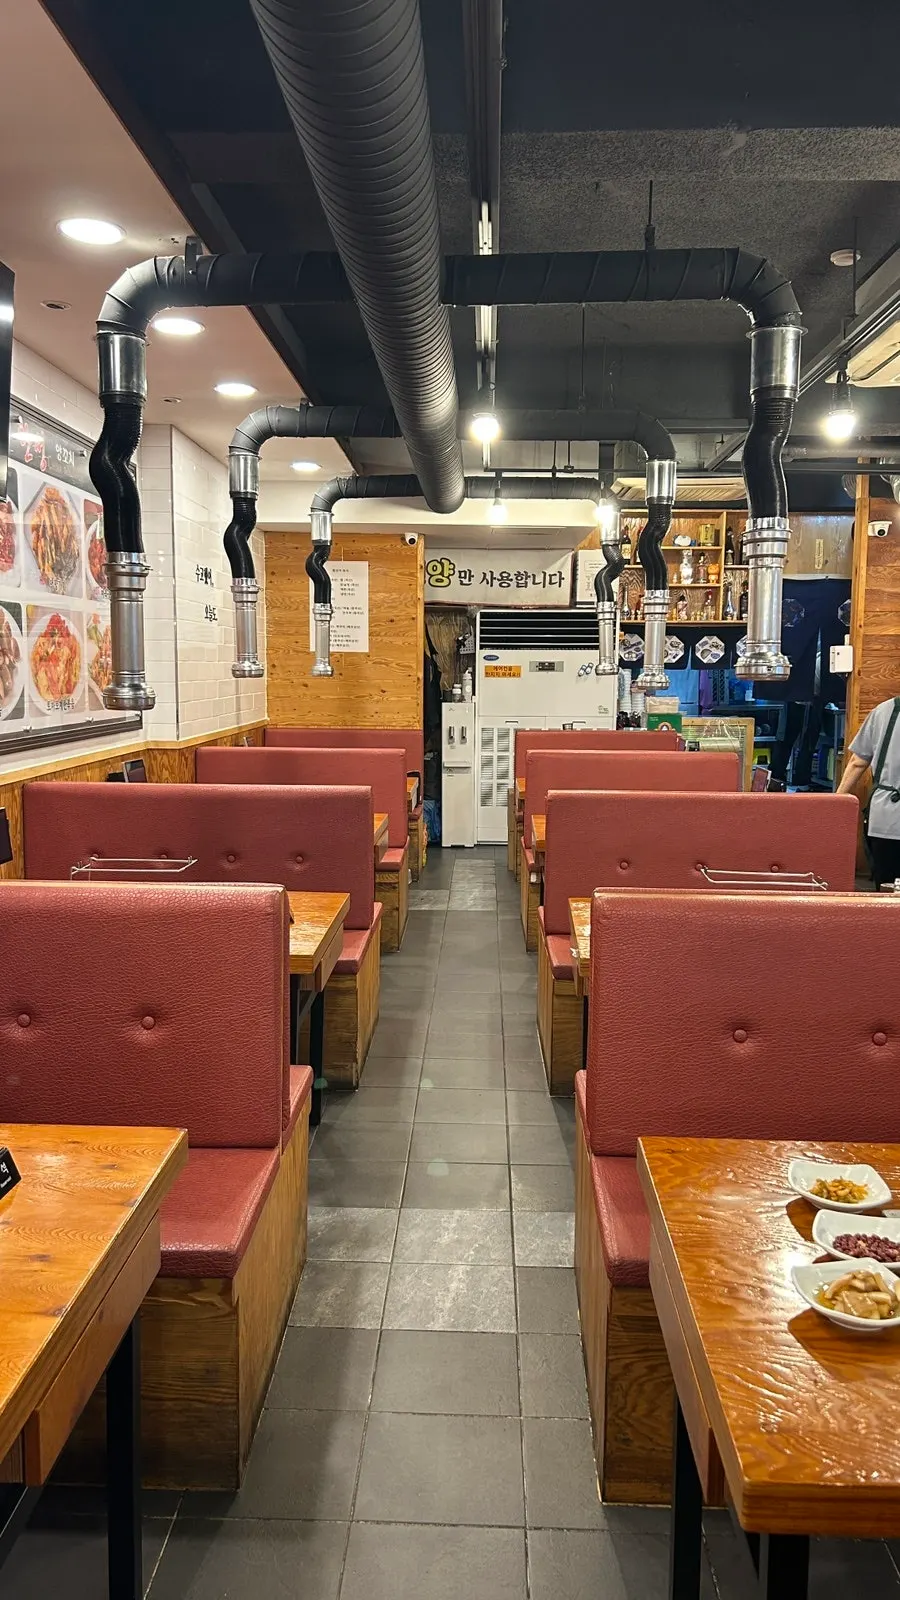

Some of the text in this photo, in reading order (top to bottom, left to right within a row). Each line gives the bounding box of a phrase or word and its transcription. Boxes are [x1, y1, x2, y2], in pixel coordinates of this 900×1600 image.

[55, 443, 75, 467] 양꼬치
[424, 557, 474, 587] 양만
[479, 570, 565, 589] 사용합니다
[204, 604, 218, 622] 오늘도
